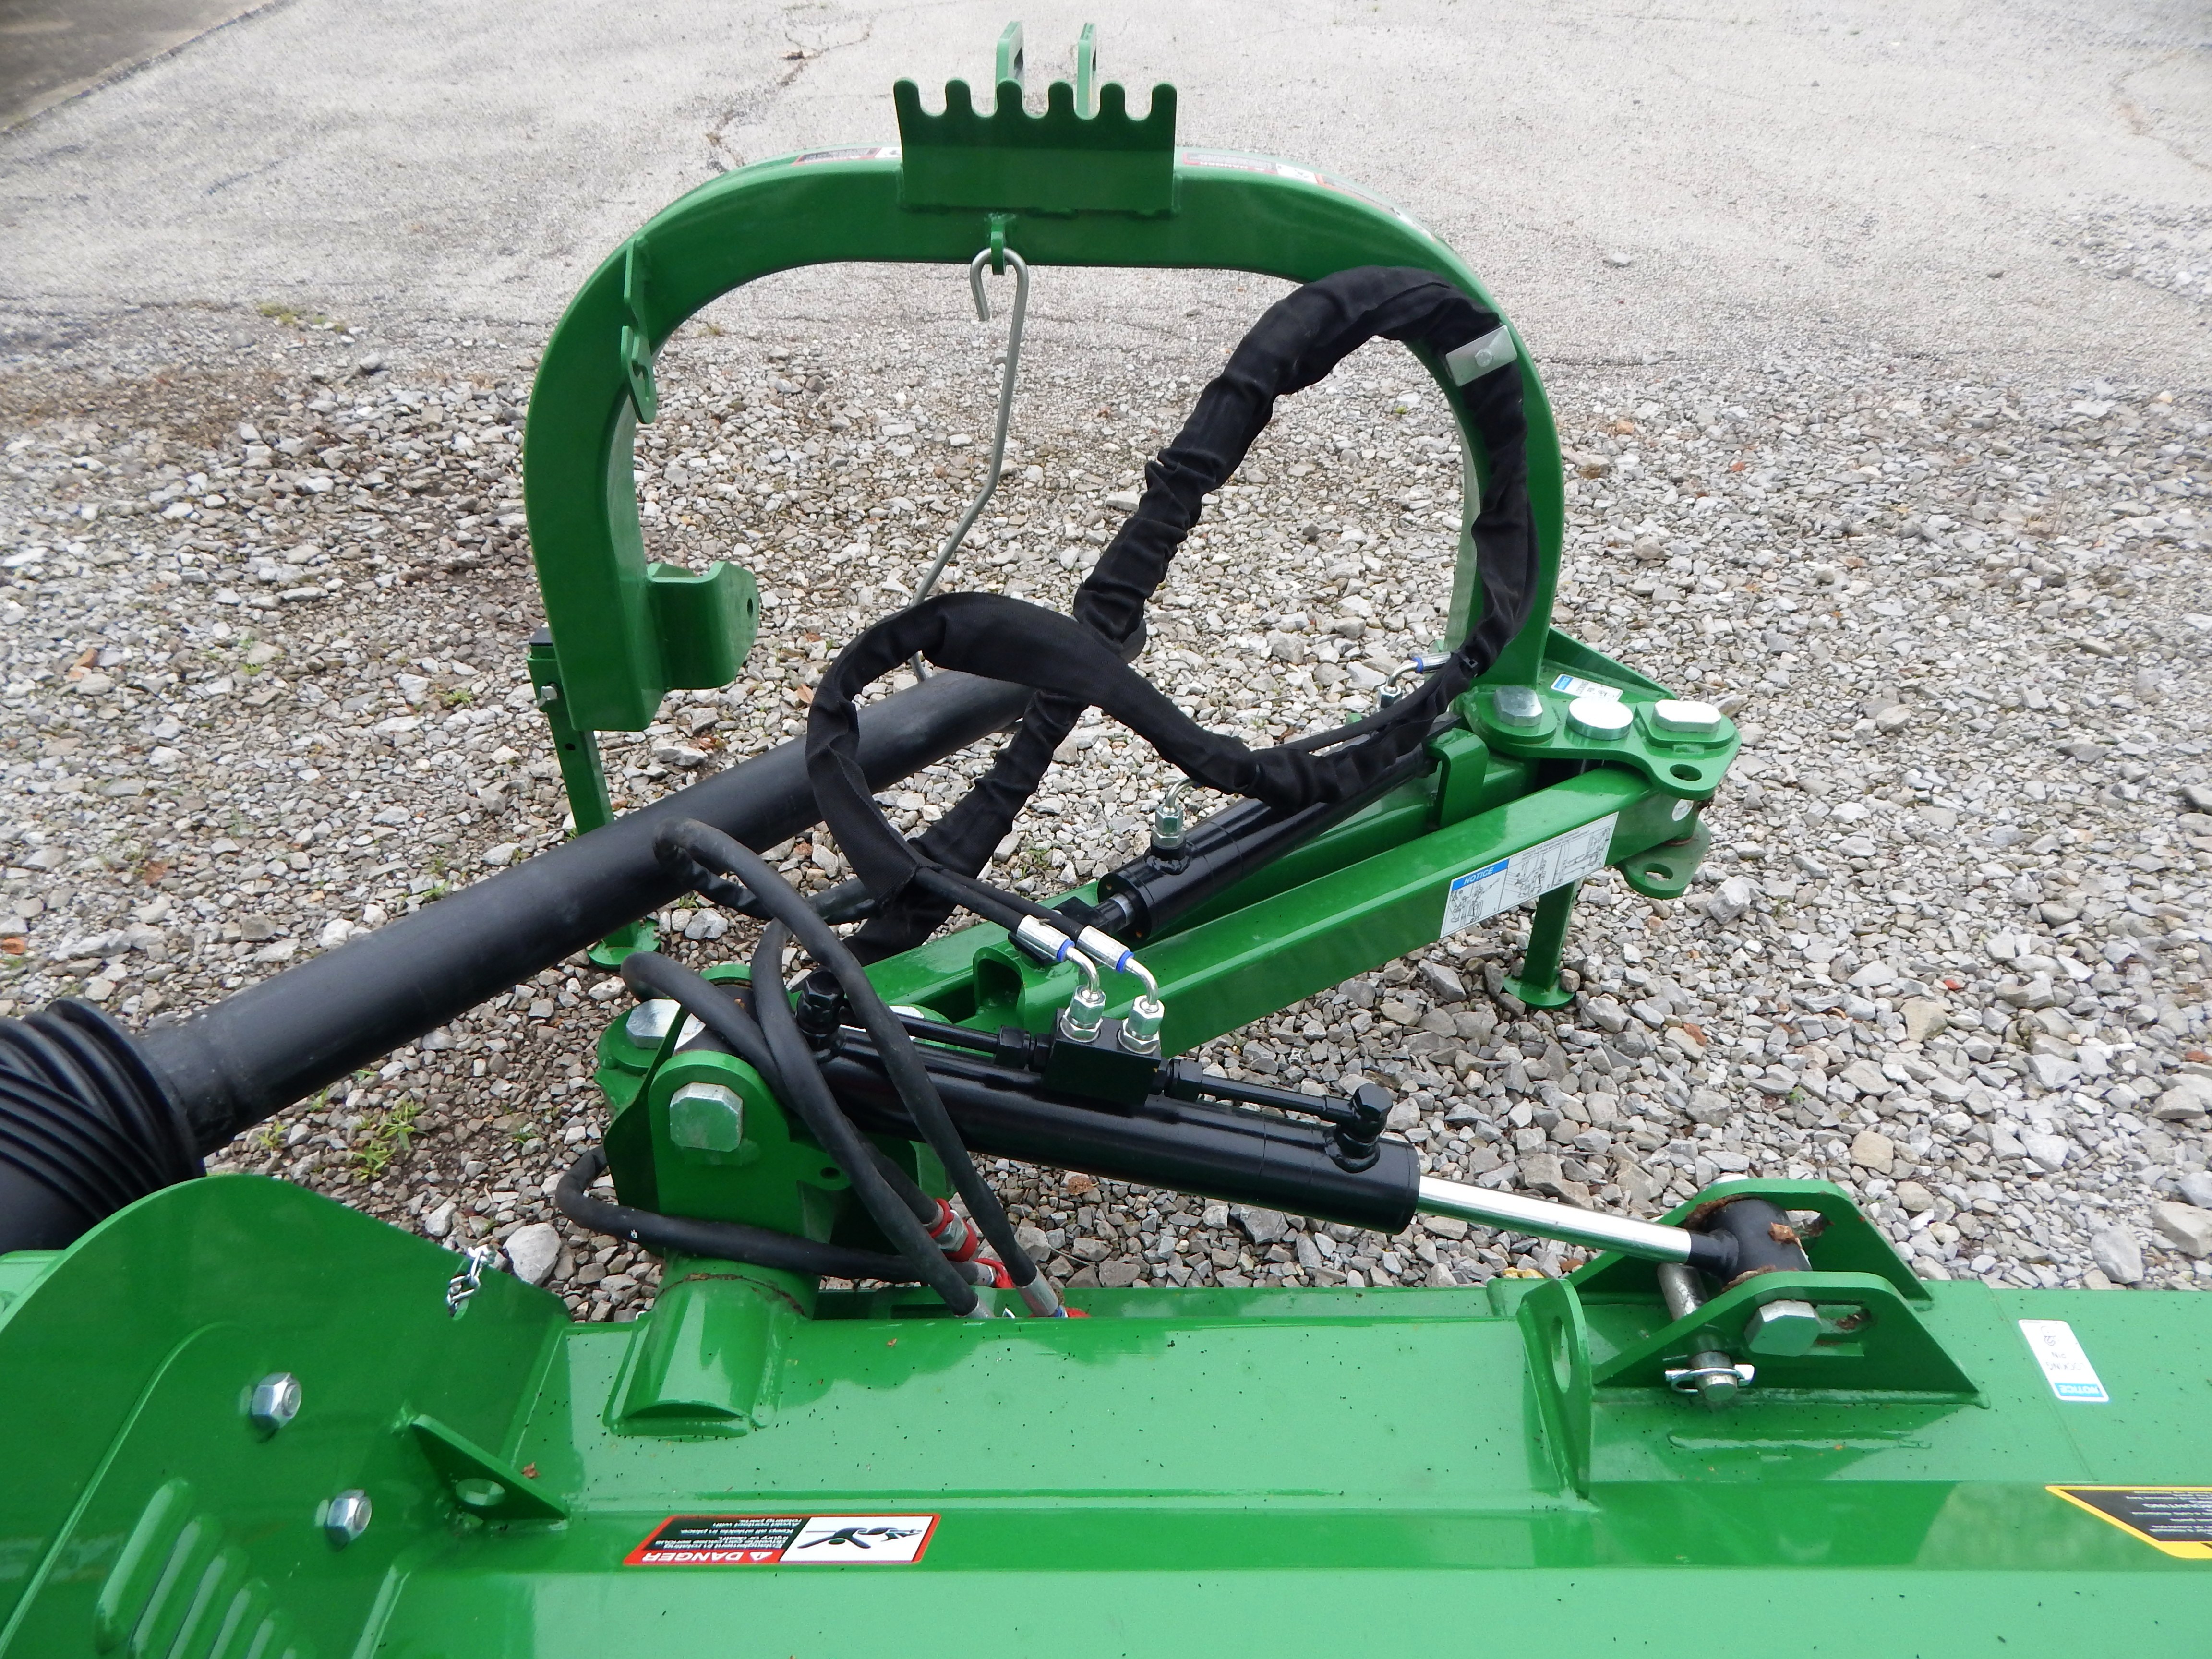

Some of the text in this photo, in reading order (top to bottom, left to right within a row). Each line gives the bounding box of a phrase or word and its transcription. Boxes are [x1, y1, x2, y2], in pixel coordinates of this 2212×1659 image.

[1463, 866, 1494, 885] NOTICE
[2058, 1385, 2100, 1395] NOTICE
[642, 1552, 744, 1561] DANGER
